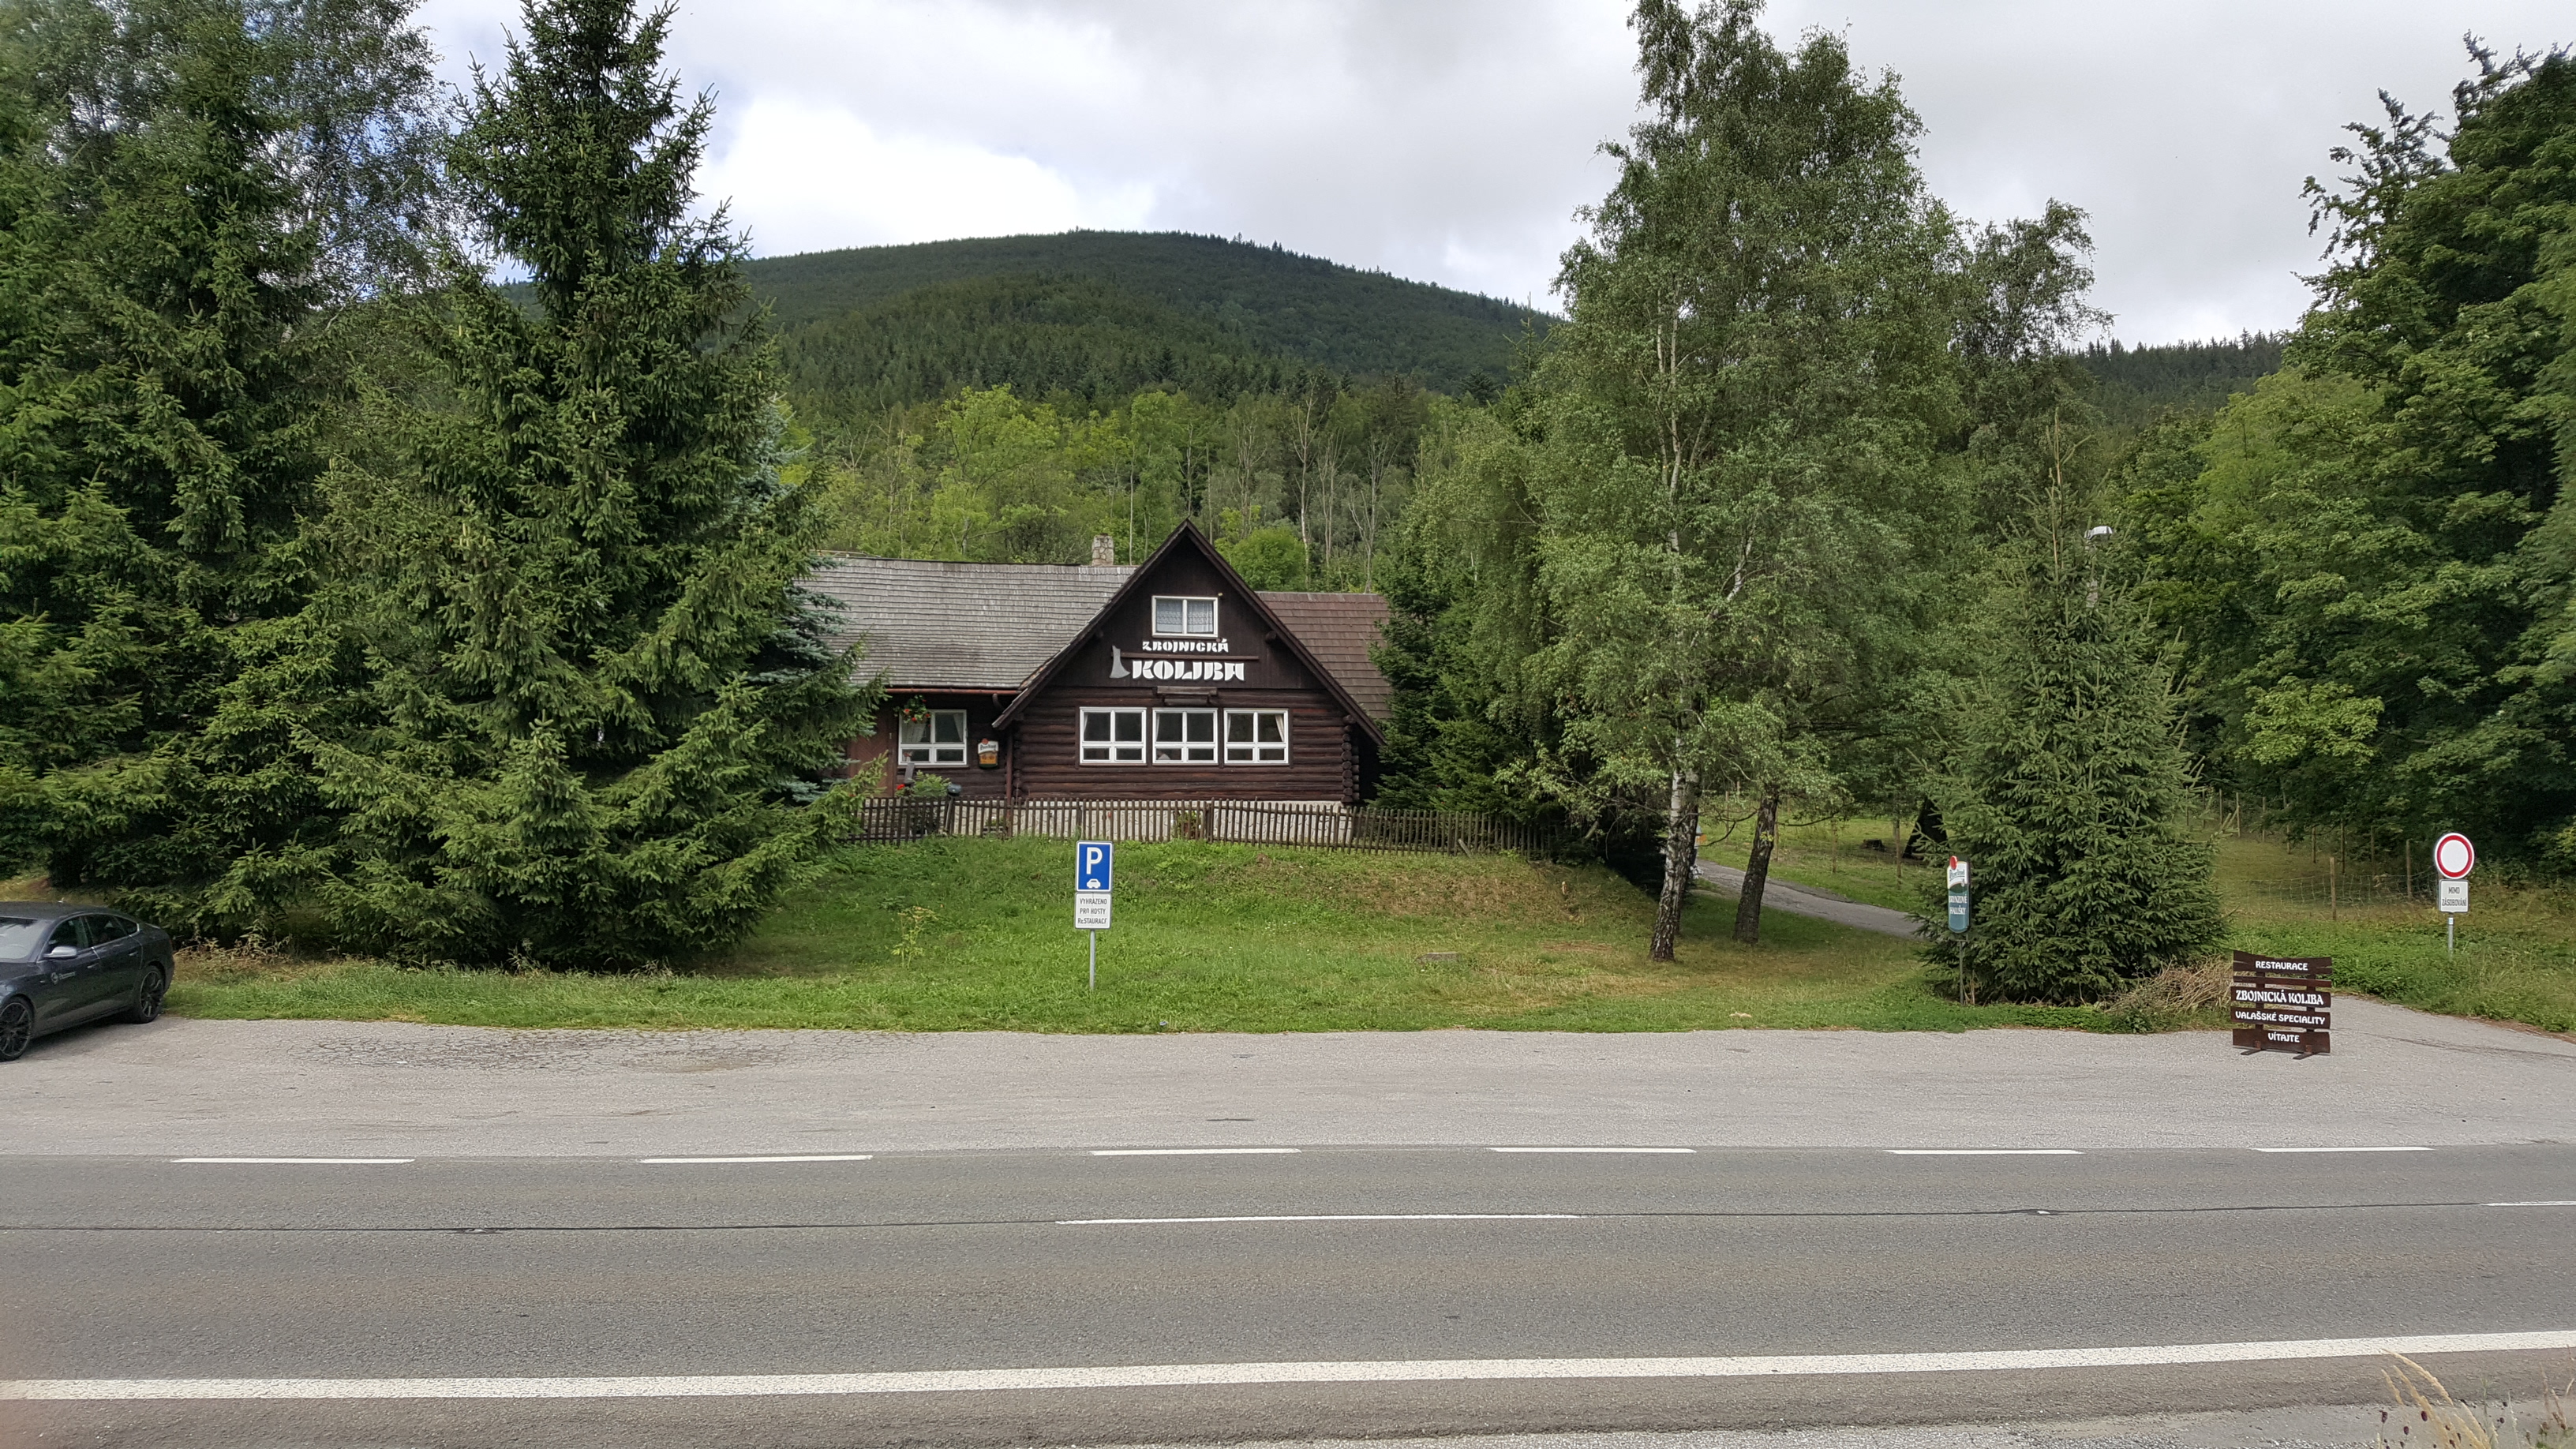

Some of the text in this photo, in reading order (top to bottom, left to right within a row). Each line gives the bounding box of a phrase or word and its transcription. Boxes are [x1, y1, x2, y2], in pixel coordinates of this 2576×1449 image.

[1142, 638, 1229, 653] ZBOJNICKÁ
[1133, 660, 1245, 681] KOLIBA
[1086, 847, 1103, 874] P
[2255, 960, 2308, 971] RESTAURACE
[2235, 989, 2324, 1005] ZBOJNICKÁ KOLIBA
[2235, 1010, 2326, 1025] VALAŠSKÉ SPECIALITY
[2267, 1031, 2301, 1043] VÍTAJTE
